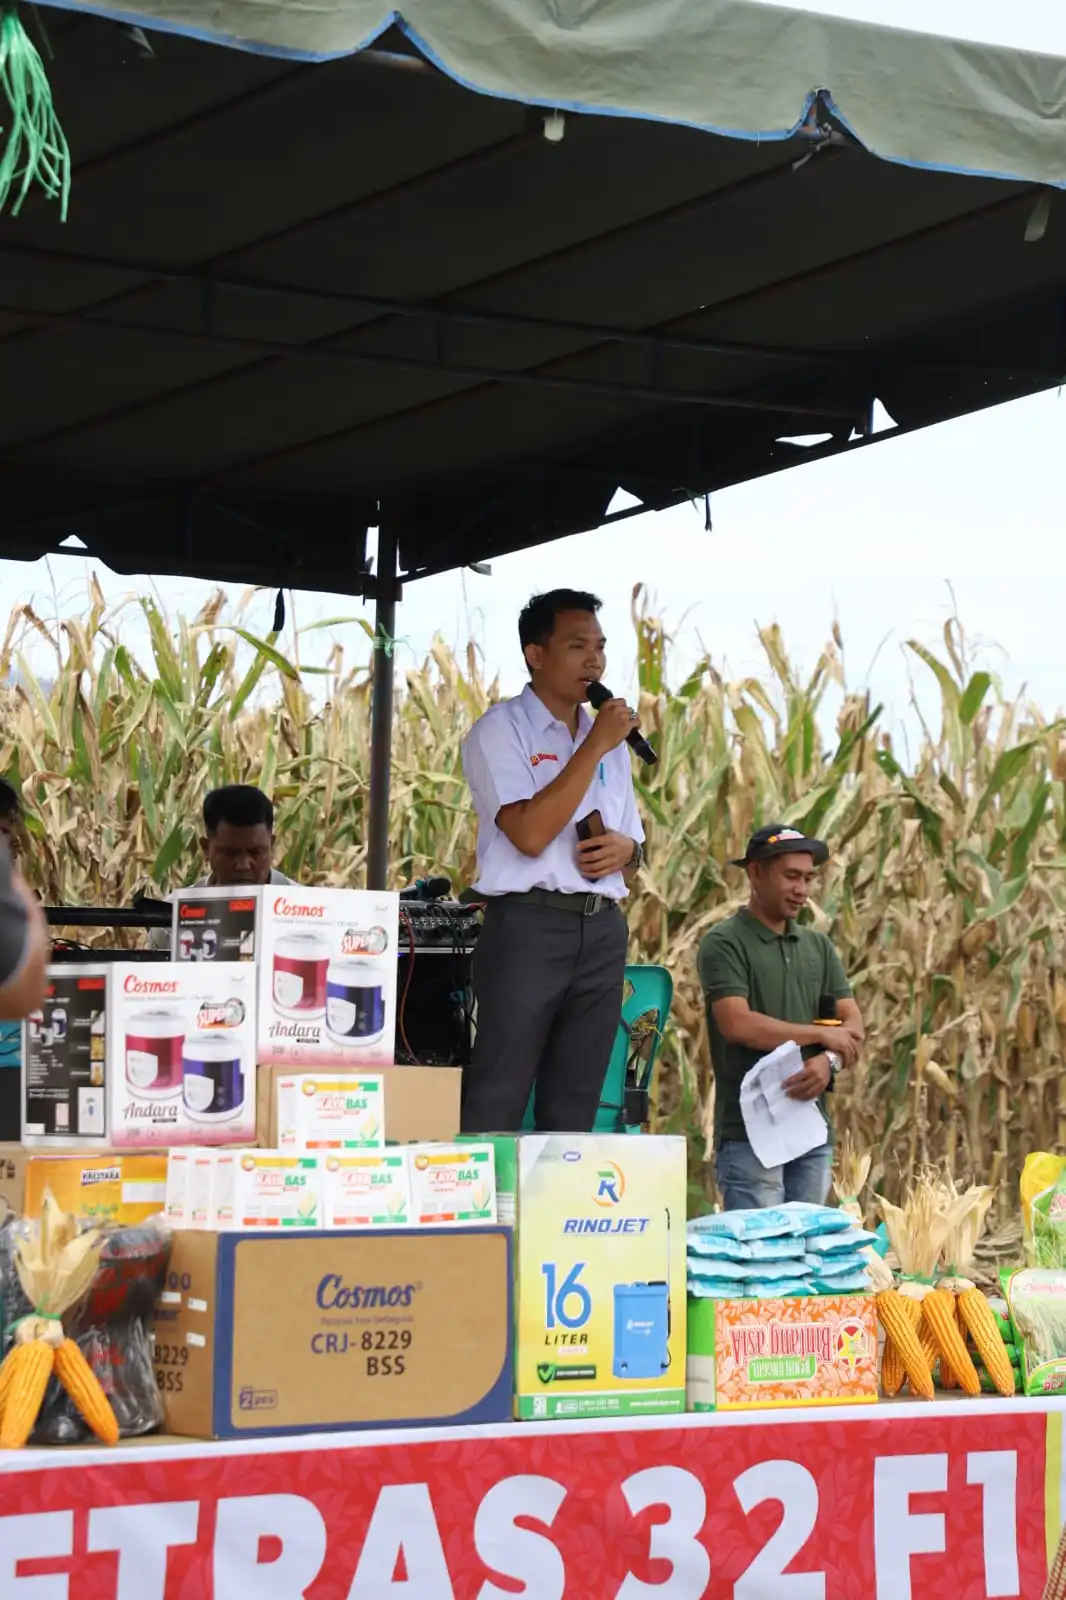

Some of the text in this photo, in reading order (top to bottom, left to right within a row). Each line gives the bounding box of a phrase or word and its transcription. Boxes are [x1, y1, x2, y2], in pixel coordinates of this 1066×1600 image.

[273, 896, 325, 917] Cosmos
[123, 974, 178, 993] Cosmos
[268, 1021, 321, 1038] Andara
[122, 1102, 178, 1119] Andara
[563, 1218, 650, 1234] RINOJET
[316, 1273, 416, 1310] Cosmos
[541, 1263, 592, 1329] 16
[544, 1333, 589, 1345] LITER
[770, 1323, 831, 1363] Bintang
[366, 1354, 406, 1376] BSS
[156, 1370, 184, 1392] BSS
[615, 1458, 826, 1600] 32
[873, 1449, 1021, 1600] F1
